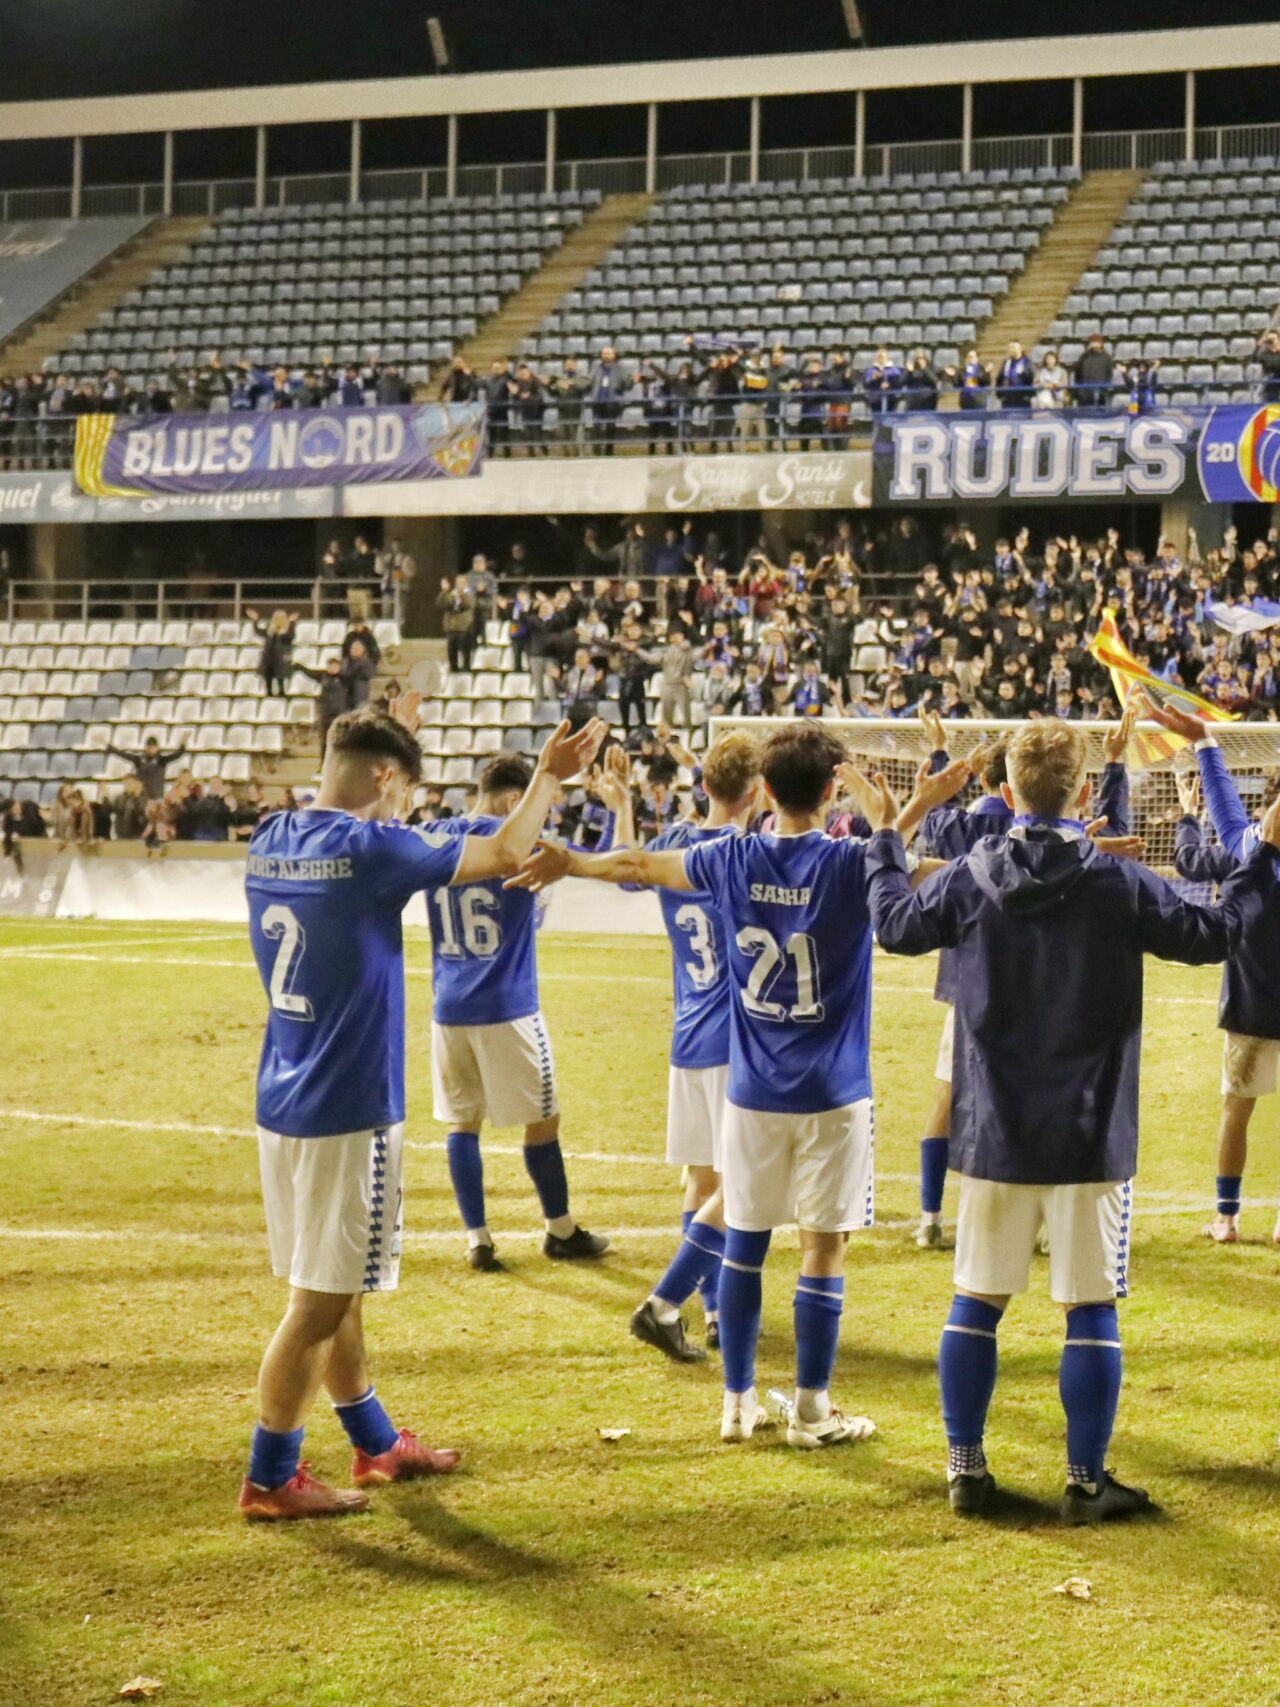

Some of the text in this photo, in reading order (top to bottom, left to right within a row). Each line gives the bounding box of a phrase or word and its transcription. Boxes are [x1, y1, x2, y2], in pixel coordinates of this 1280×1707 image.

[123, 427, 254, 477] BLUES
[758, 457, 847, 508] Sansi
[890, 414, 1187, 500] RUDES
[1206, 442, 1236, 462] 20
[278, 856, 353, 880] ALEGRE
[751, 884, 811, 906] SASHA
[434, 885, 502, 961] 16
[675, 904, 719, 990] 3
[261, 904, 315, 1022] 2
[735, 926, 825, 1023] 21
